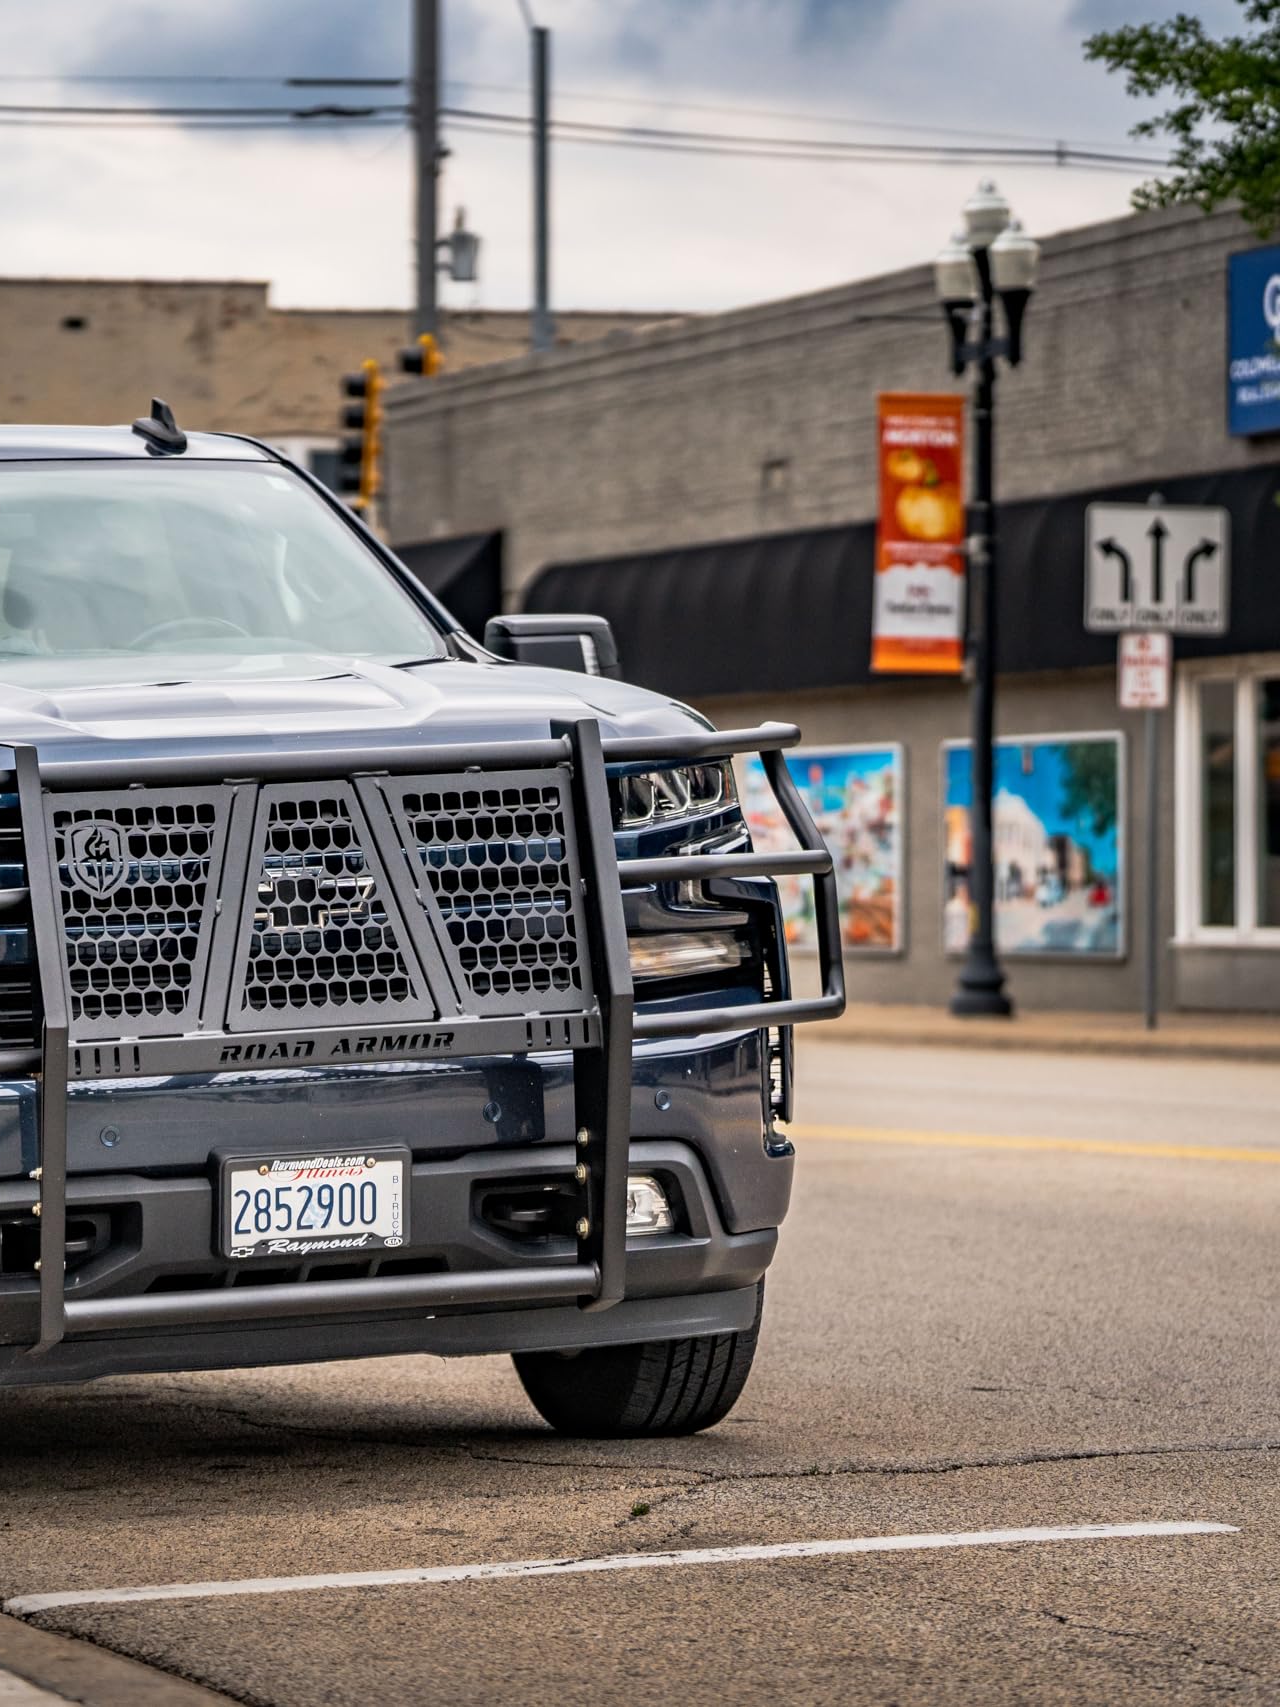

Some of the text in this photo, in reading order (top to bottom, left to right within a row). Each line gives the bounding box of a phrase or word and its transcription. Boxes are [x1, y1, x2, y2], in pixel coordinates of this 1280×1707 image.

[219, 1032, 455, 1064] ROAD ARMOR
[271, 1156, 366, 1172] RaymondDeals.com
[392, 1175, 399, 1184] B
[234, 1181, 378, 1235] 2852900
[267, 1233, 369, 1255] Raymond
[386, 1237, 400, 1246] KIA
